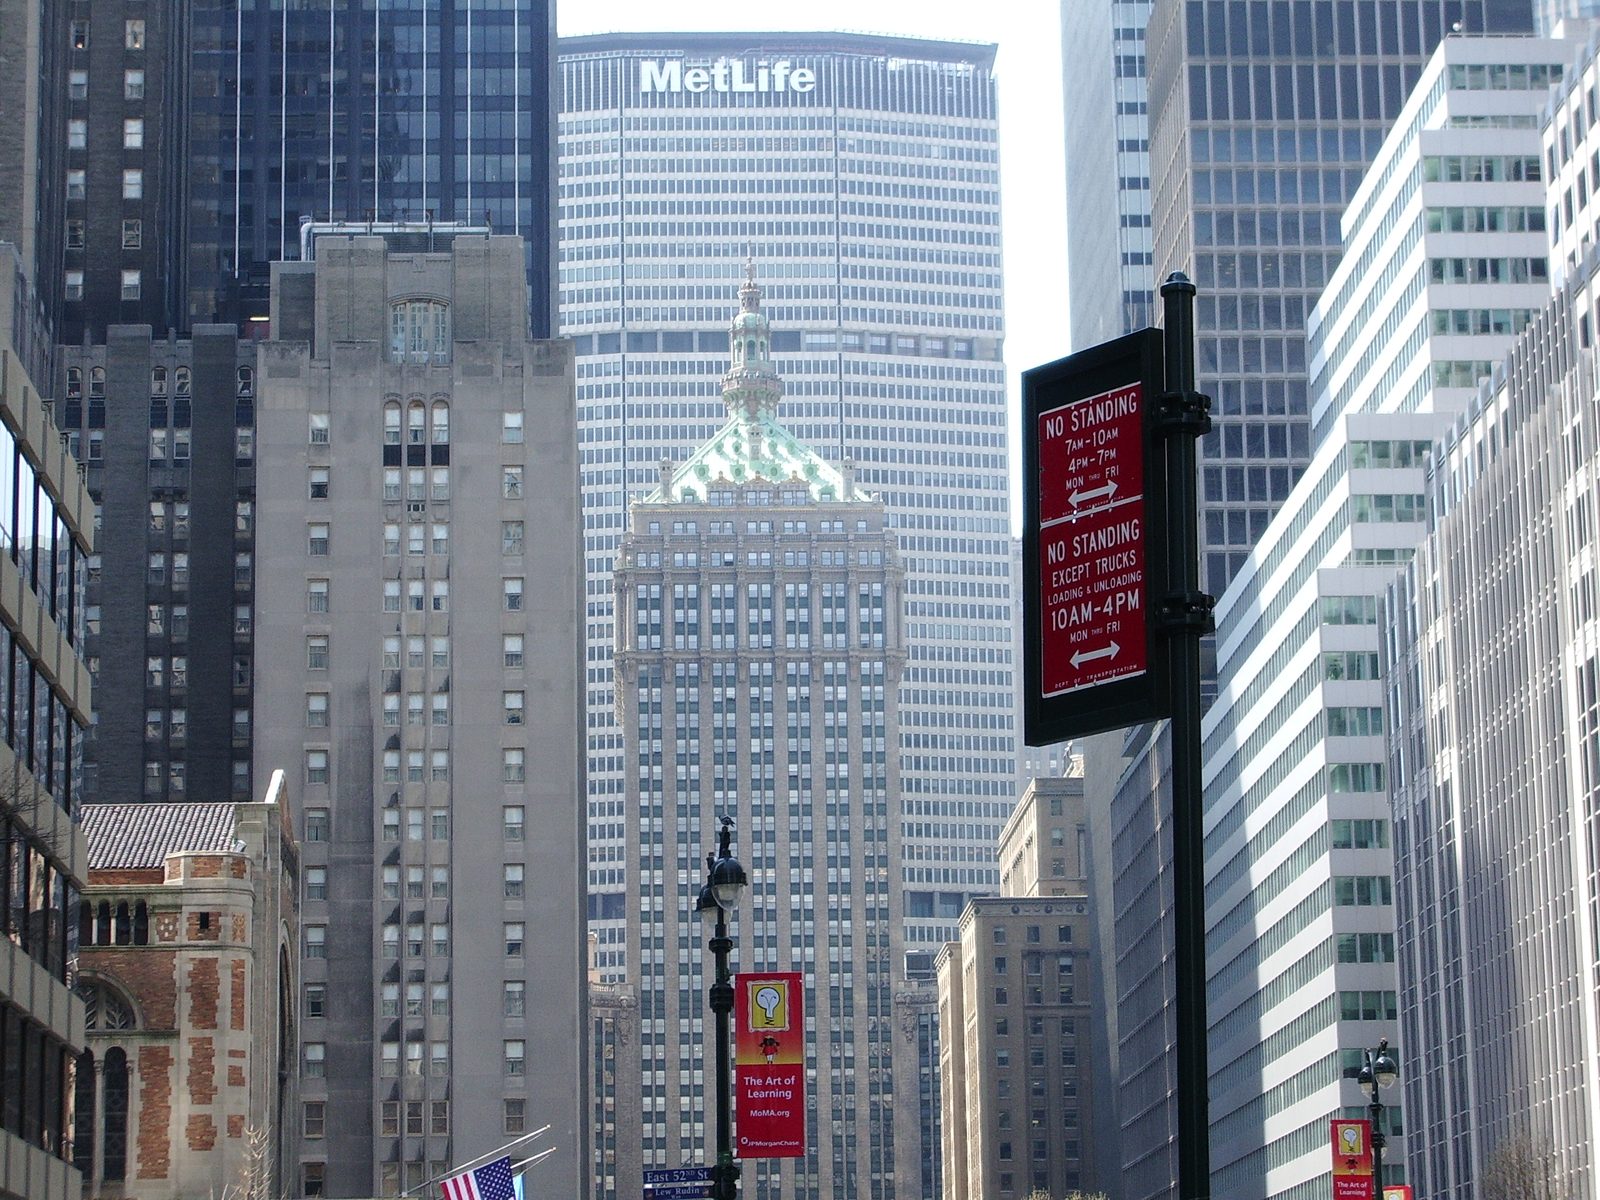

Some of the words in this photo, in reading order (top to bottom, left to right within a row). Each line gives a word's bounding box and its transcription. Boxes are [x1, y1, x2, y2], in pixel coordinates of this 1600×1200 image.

[640, 60, 816, 92] MetLife
[1046, 416, 1063, 440] NO
[1071, 392, 1137, 432] STANDING
[1066, 476, 1084, 490] MON
[1105, 465, 1119, 478] FRI
[1048, 541, 1065, 565] NO
[1073, 519, 1139, 557] STANDING
[1052, 563, 1090, 588] EXCEPT
[1096, 550, 1136, 575] TRUCKS
[1048, 587, 1083, 606] LOADING
[1087, 586, 1091, 594] &
[1094, 570, 1142, 593] UNLOADING
[1052, 588, 1139, 631] 10AM-4PM
[1070, 629, 1088, 643] MON
[1091, 627, 1103, 635] THRU
[1106, 621, 1120, 634] FRI
[1087, 664, 1137, 680] TRANSPORTATION
[744, 1076, 763, 1086] The
[765, 1076, 782, 1086] Art
[784, 1075, 796, 1085] of
[748, 1088, 792, 1100] Learning
[750, 1110, 790, 1118] MoMA.org
[646, 1171, 669, 1182] East
[697, 1168, 709, 1180] St
[655, 1187, 671, 1196] Lew
[675, 1186, 700, 1195] Rudin
